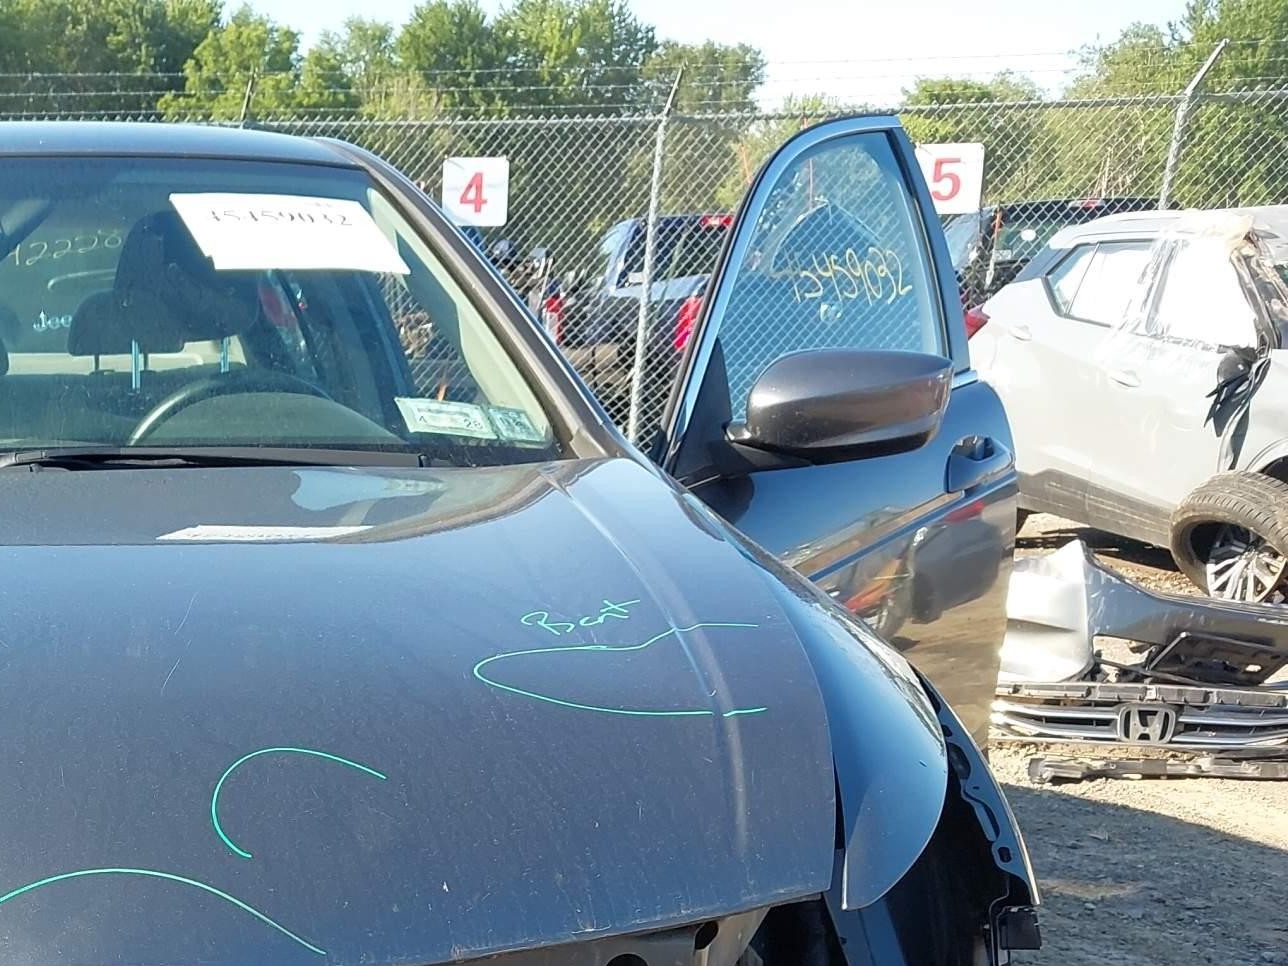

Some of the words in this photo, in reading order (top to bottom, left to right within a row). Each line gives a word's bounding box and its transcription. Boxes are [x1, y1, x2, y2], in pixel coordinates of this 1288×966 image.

[459, 172, 488, 213] 4
[931, 157, 962, 201] 5
[33, 309, 72, 332] Jee
